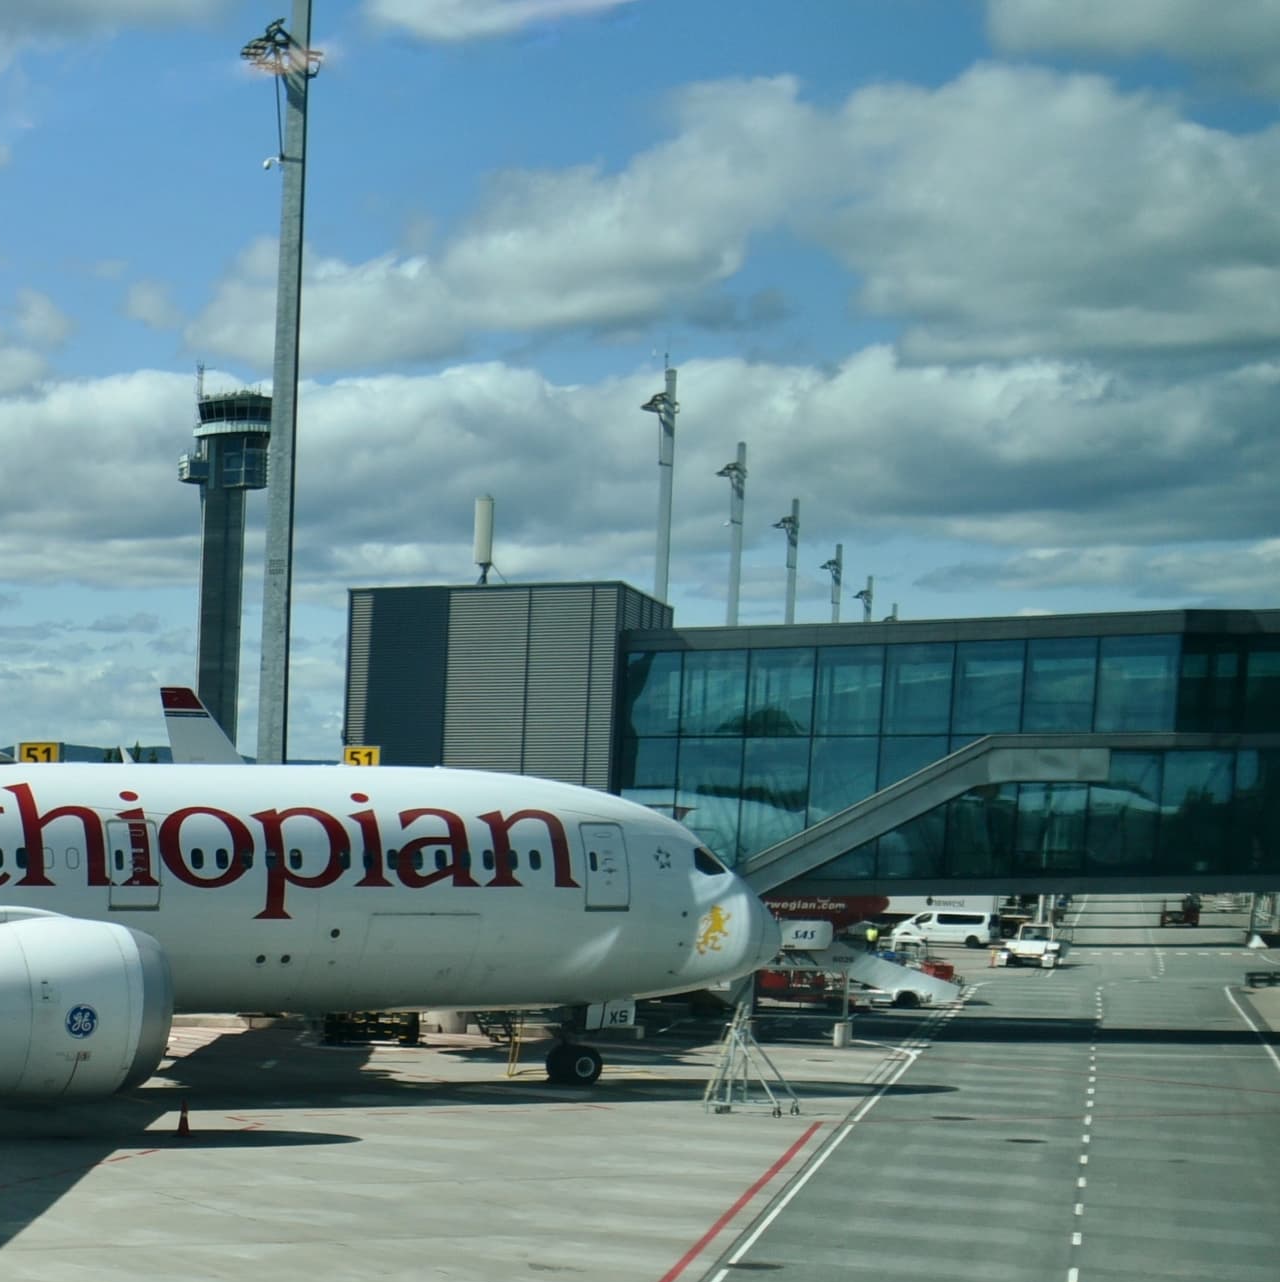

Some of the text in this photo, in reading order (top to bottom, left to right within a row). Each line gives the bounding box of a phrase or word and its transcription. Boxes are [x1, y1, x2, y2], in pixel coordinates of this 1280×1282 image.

[25, 746, 52, 763] 51
[349, 750, 373, 766] 51
[791, 929, 817, 940] SAS
[609, 1009, 629, 1025] XS
